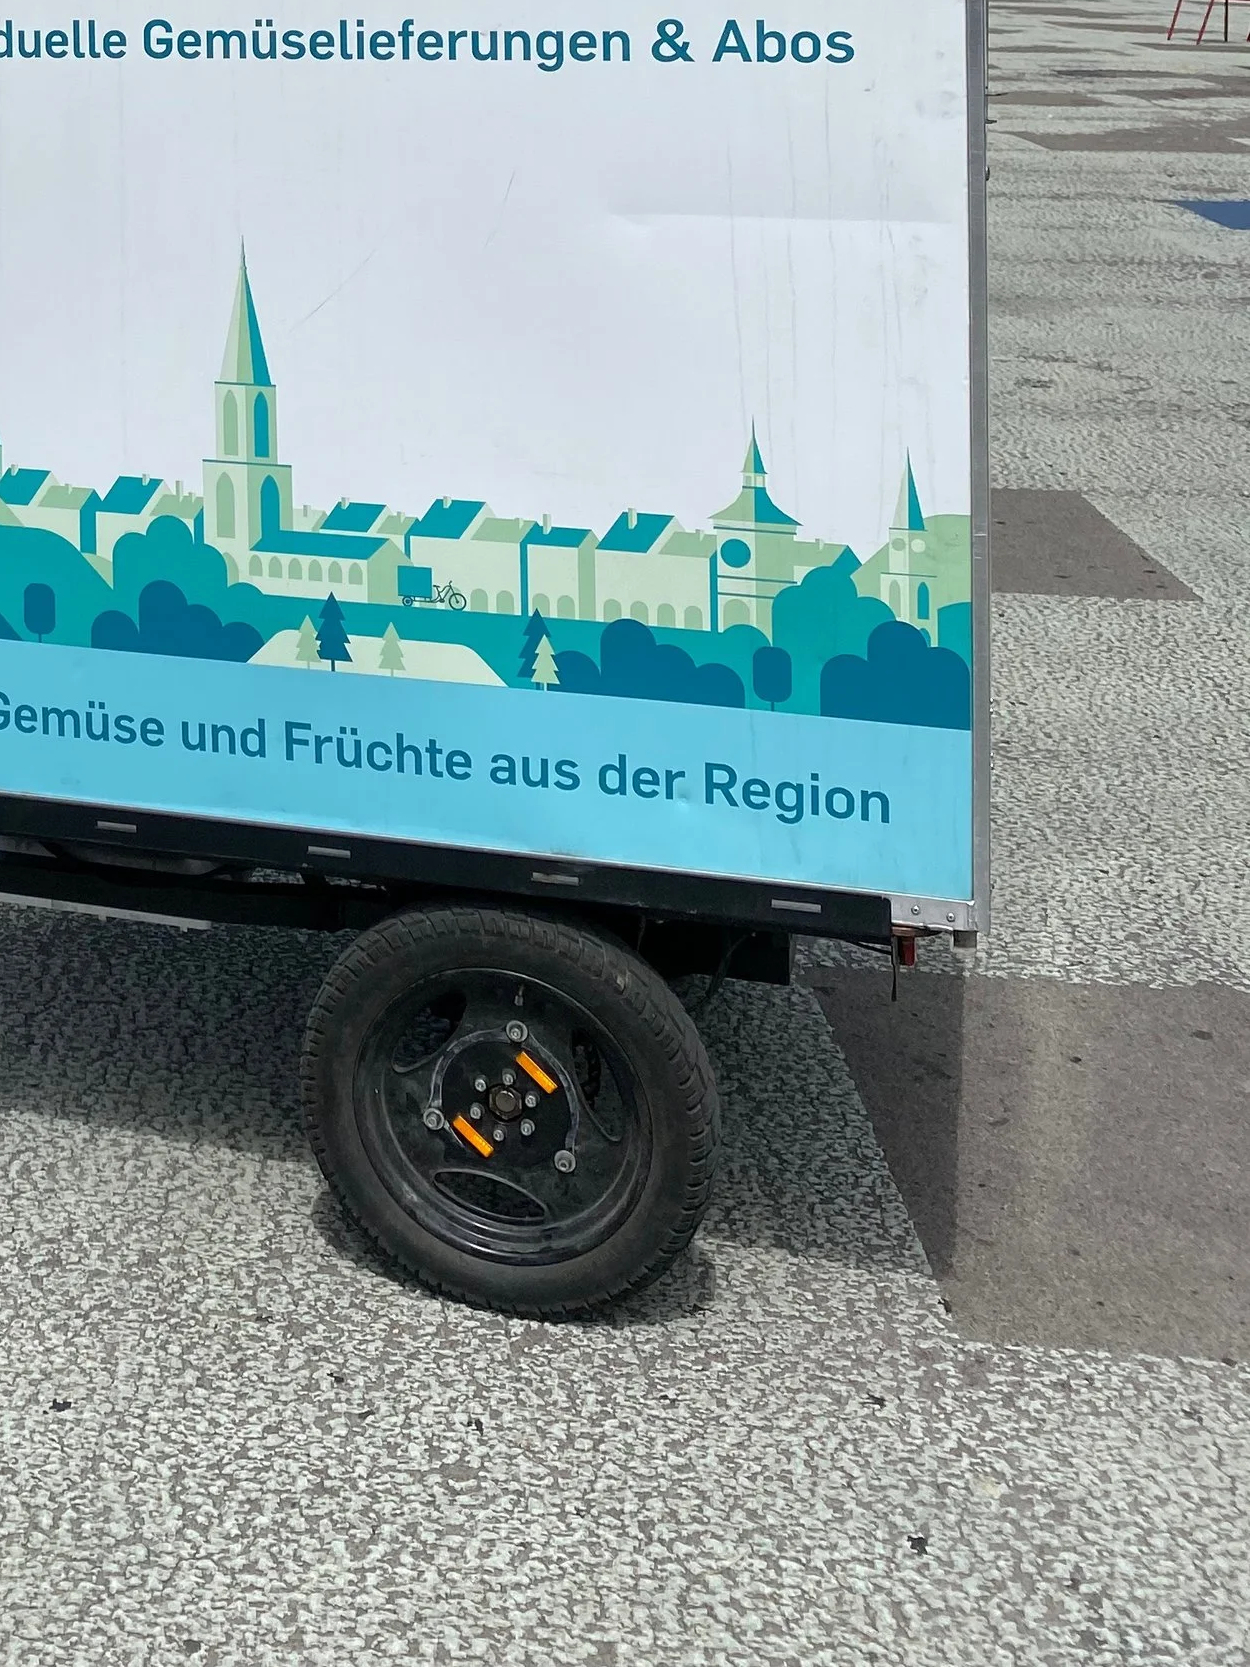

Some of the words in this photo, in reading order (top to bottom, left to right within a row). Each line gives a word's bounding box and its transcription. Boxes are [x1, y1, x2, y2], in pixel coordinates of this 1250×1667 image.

[143, 18, 631, 73] Gemüselieferungen
[651, 18, 695, 63] &
[711, 19, 855, 64] Abos
[181, 717, 267, 759] und
[284, 720, 472, 781] Früchte
[489, 753, 581, 791] aus
[598, 753, 686, 800] der
[704, 762, 890, 825] Region
